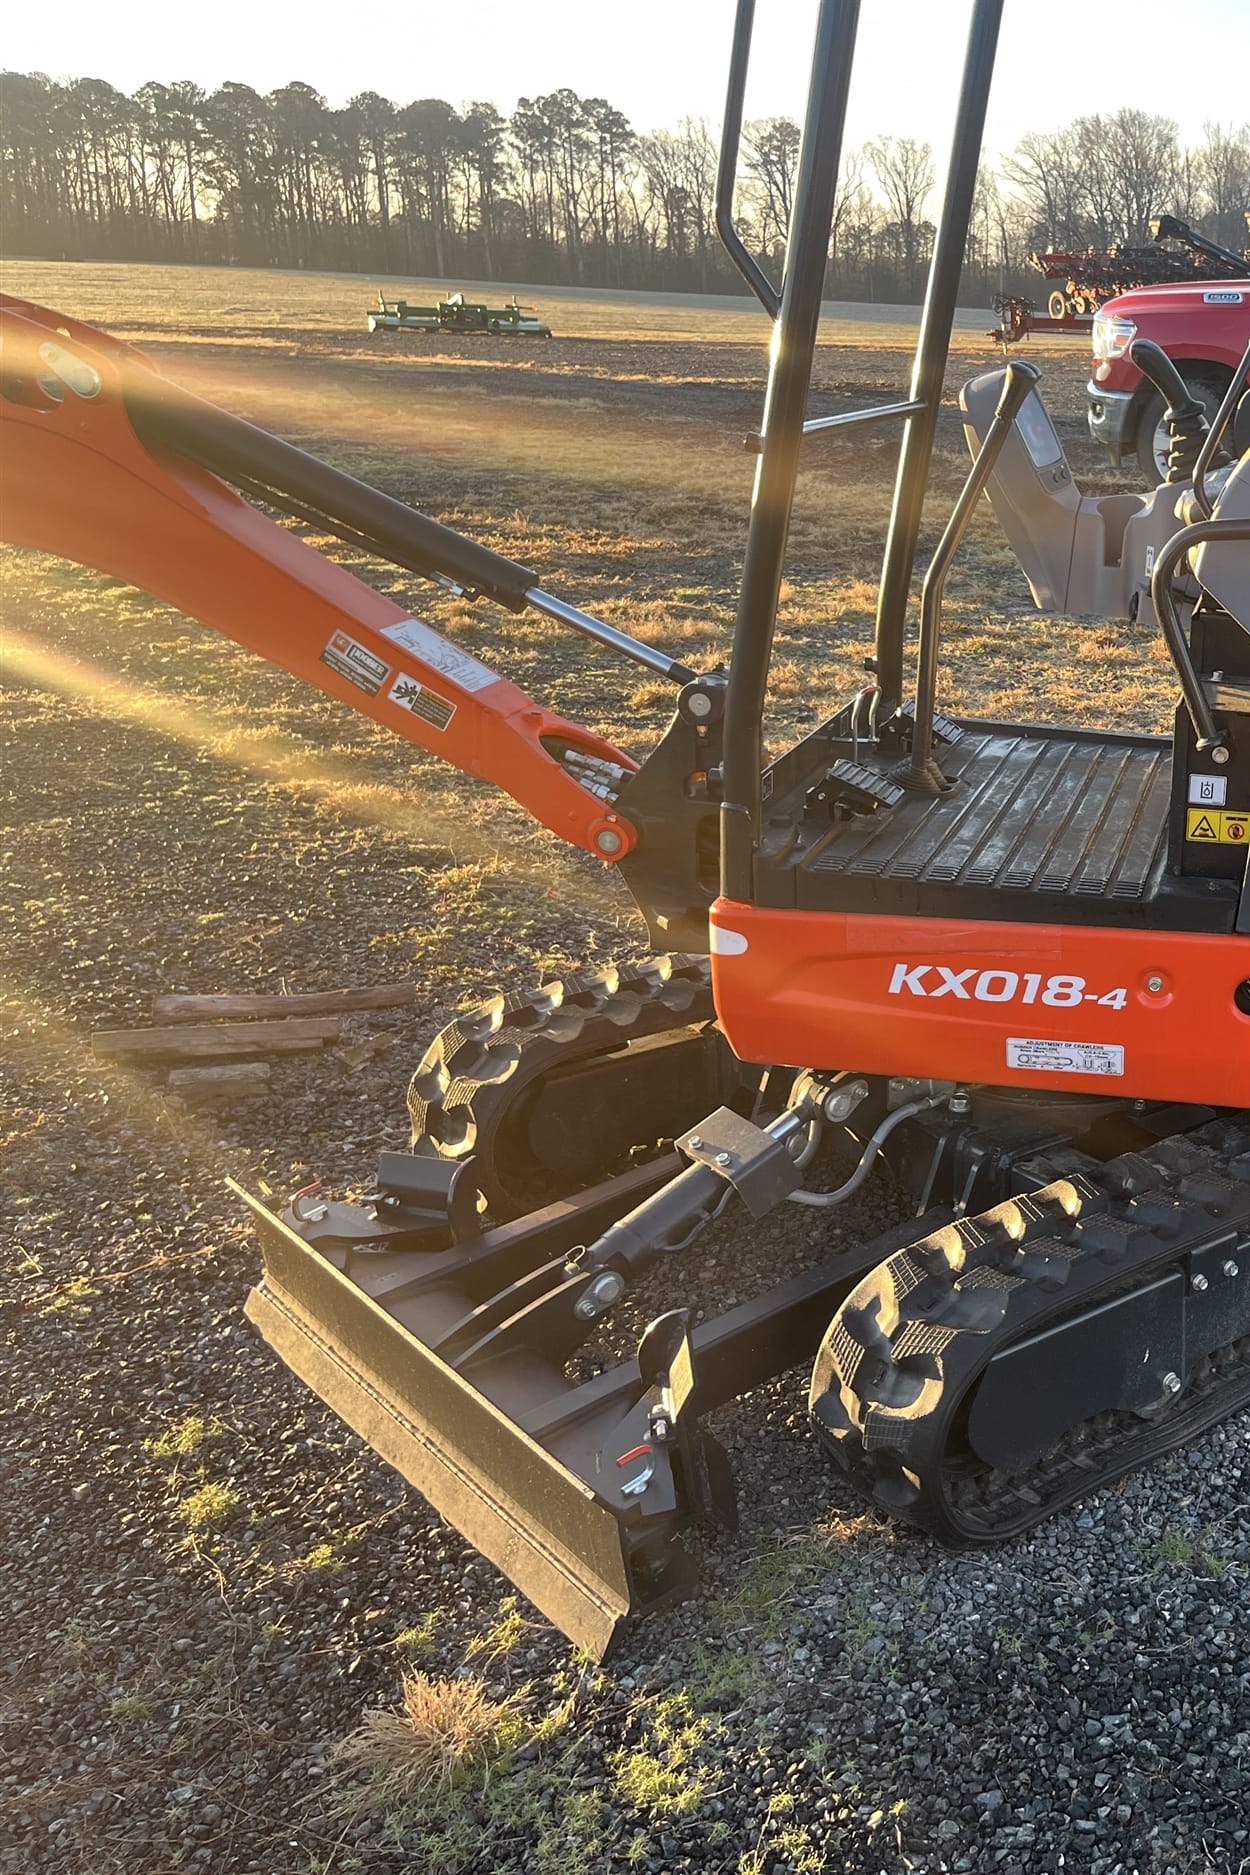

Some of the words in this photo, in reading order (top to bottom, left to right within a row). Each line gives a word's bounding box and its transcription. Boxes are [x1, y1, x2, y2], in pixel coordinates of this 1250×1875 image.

[888, 963, 1128, 1010] KX018-4
[1025, 1040, 1063, 1048] ADJUSTMENT
[1073, 1043, 1104, 1051] CRAWLERS
